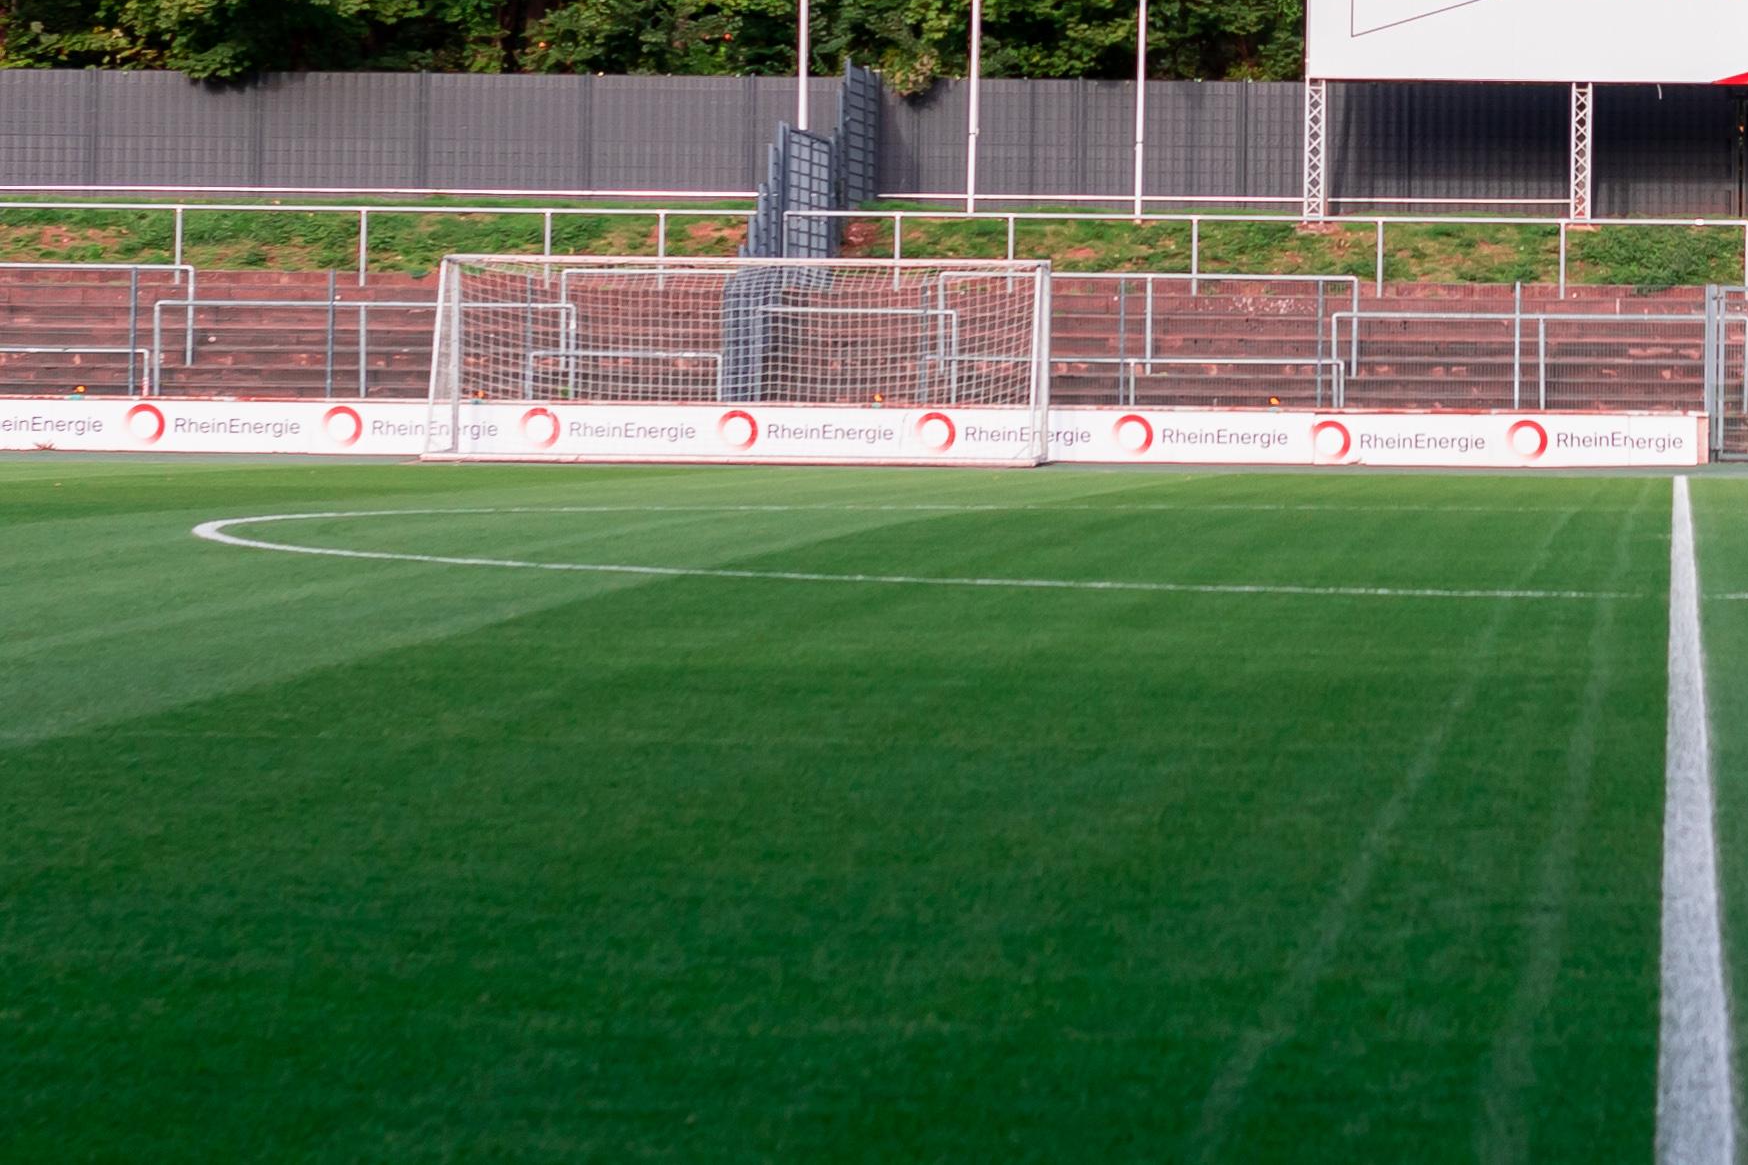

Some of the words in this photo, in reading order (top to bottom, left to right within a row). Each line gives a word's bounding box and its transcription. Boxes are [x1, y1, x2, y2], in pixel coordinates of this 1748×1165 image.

[173, 417, 301, 438] RheinEnergie
[569, 421, 697, 442] RheinEnergie
[767, 423, 895, 445] RheinEnergie
[1161, 428, 1289, 449] RheinEnergie
[1360, 432, 1486, 451] RheinEnergie
[1556, 431, 1684, 454] RheinEnergie
